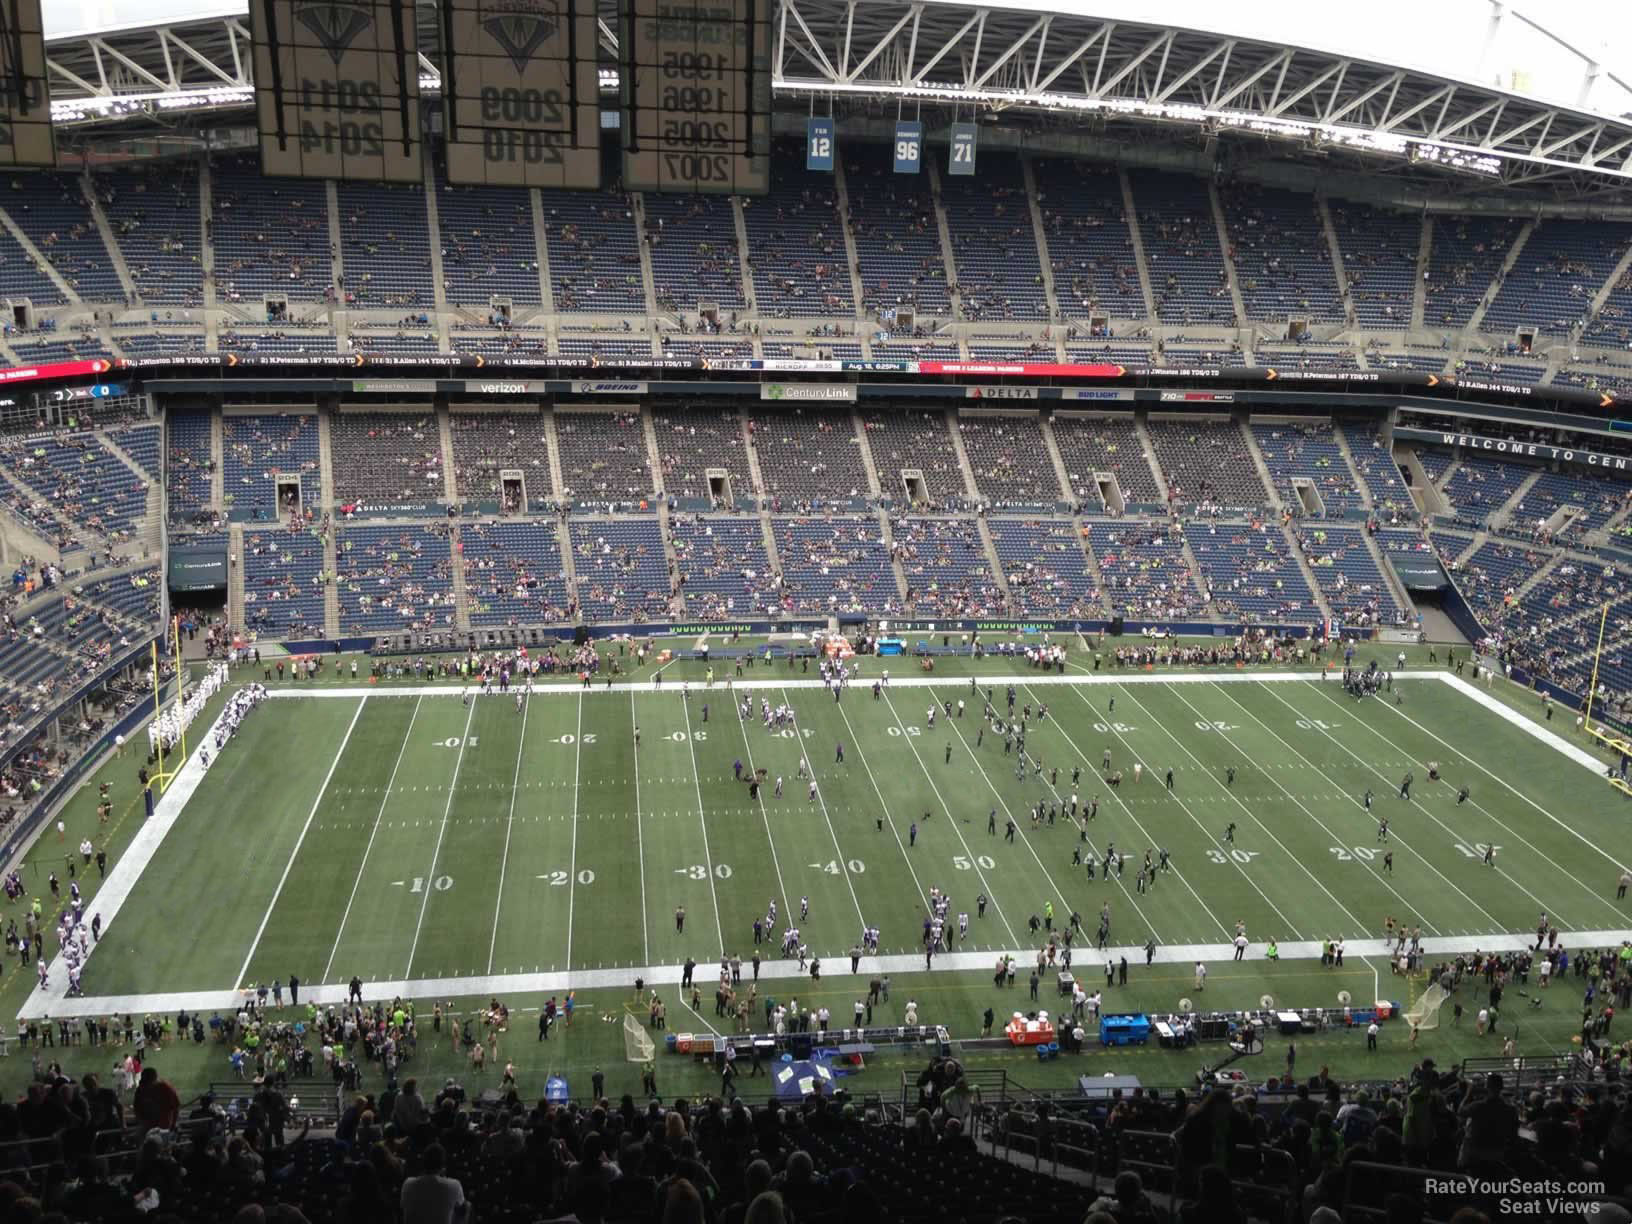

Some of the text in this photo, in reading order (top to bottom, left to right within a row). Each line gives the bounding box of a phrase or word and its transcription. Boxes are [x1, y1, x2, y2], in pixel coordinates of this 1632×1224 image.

[811, 138, 830, 157] 12
[896, 141, 919, 160] 96
[954, 143, 972, 162] 71
[481, 382, 526, 393] verizon
[786, 387, 849, 399] CenturyLink
[988, 389, 1032, 398] DELTA
[1443, 434, 1627, 469] WELCOME TO CEN
[824, 860, 866, 874] 40
[953, 856, 996, 870] 50
[550, 870, 595, 886] 20
[689, 864, 732, 880] 30
